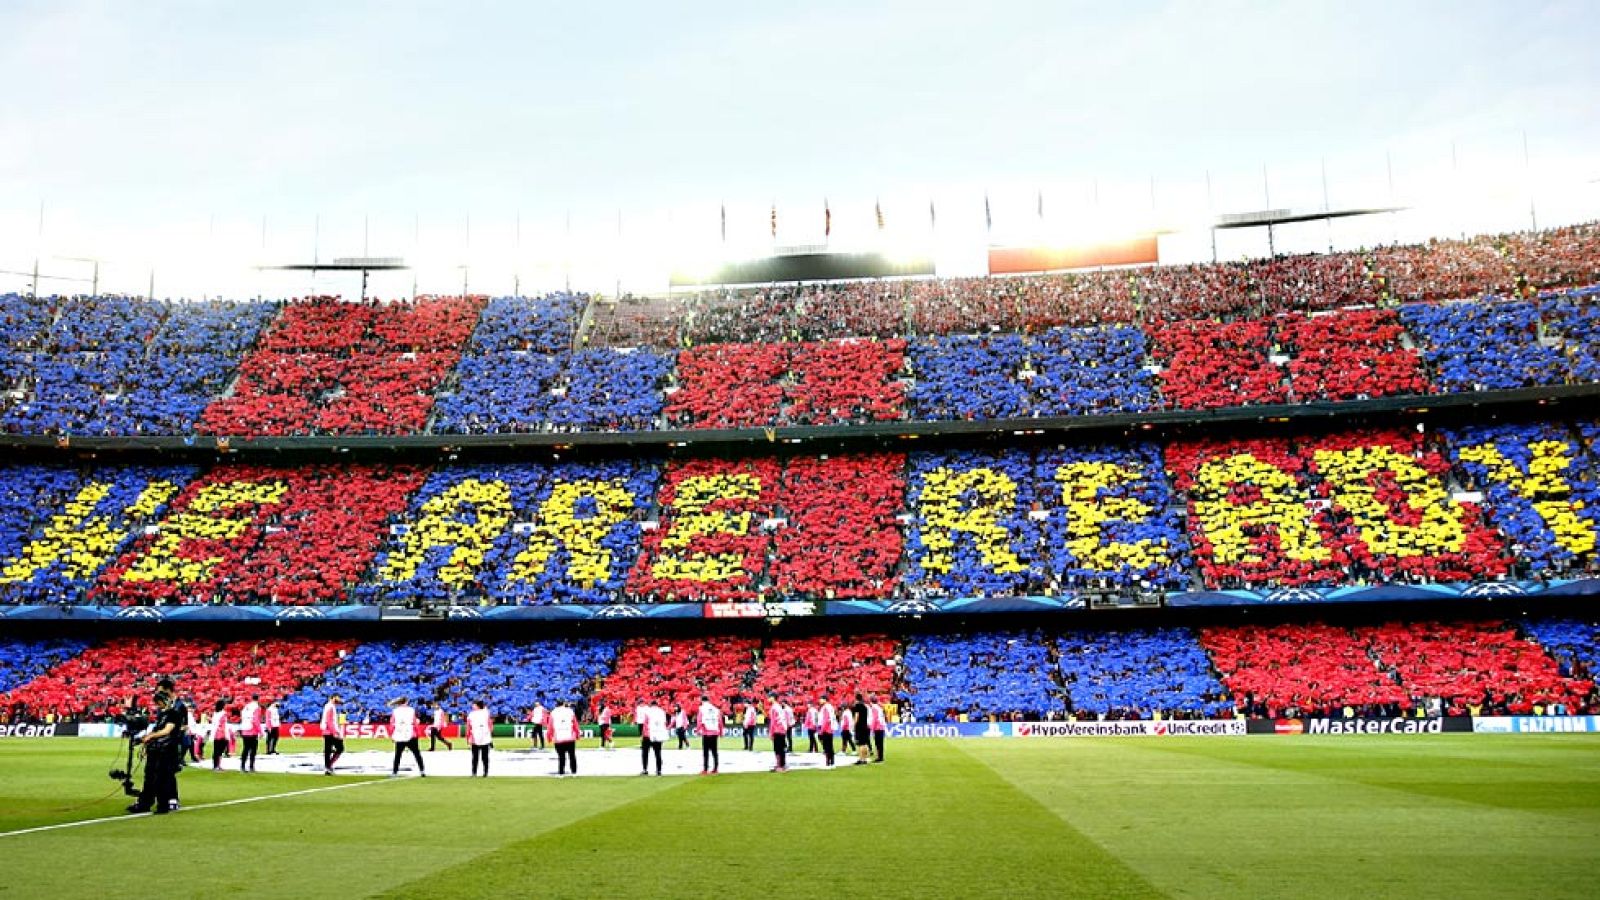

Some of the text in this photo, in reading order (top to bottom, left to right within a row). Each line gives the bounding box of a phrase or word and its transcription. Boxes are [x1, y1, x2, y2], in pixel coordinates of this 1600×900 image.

[377, 478, 764, 587] ARE
[919, 440, 1598, 573] READY
[340, 723, 388, 738] ISSA
[884, 723, 959, 737] yStation
[1031, 721, 1147, 736] HypoVereinsbank
[1168, 721, 1227, 735] UniCredit
[1308, 716, 1443, 734] MasterCard
